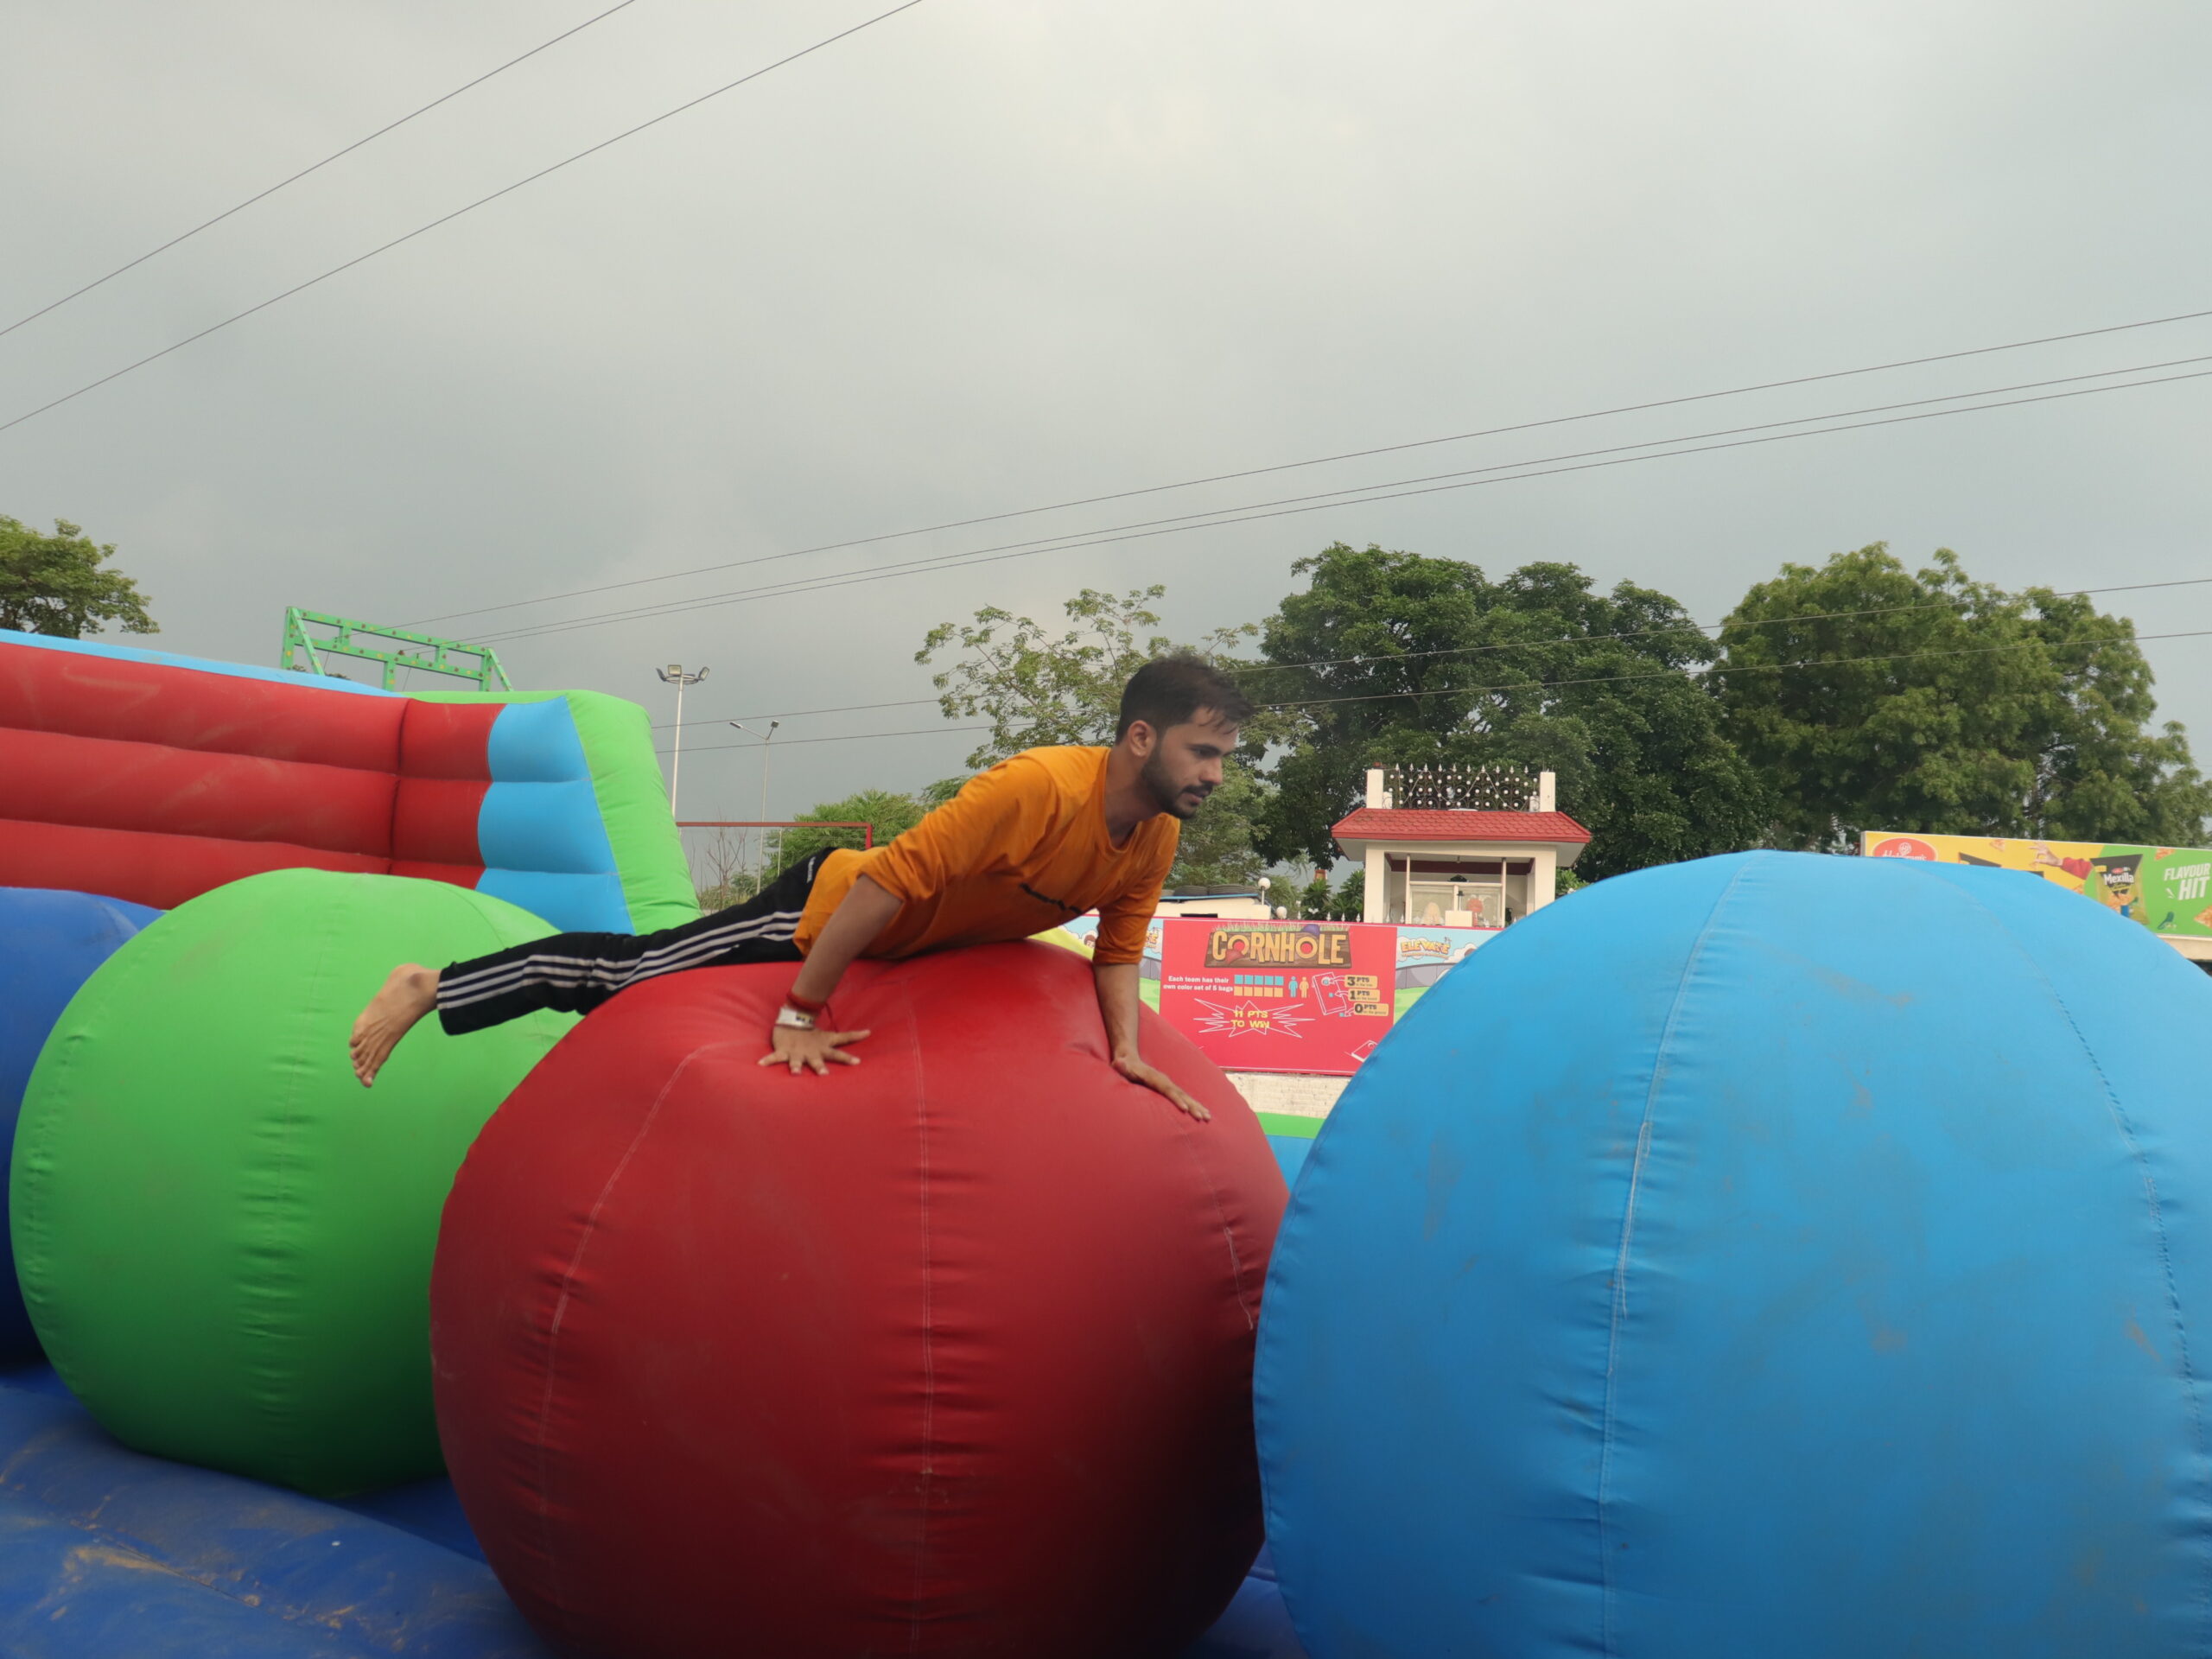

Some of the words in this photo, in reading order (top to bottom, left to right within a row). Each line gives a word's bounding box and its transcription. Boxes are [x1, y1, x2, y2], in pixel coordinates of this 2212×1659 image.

[2164, 863, 2210, 880] FLAVOUR
[2103, 872, 2134, 885] Mexilla
[2177, 876, 2210, 900] HIT
[1212, 931, 1346, 965] CORNHOLE
[1401, 940, 1451, 955] ELEVATE
[1347, 976, 1356, 986] 3
[1350, 990, 1356, 1000] 1
[1247, 1010, 1268, 1019] PTS
[1355, 1003, 1363, 1014] 0
